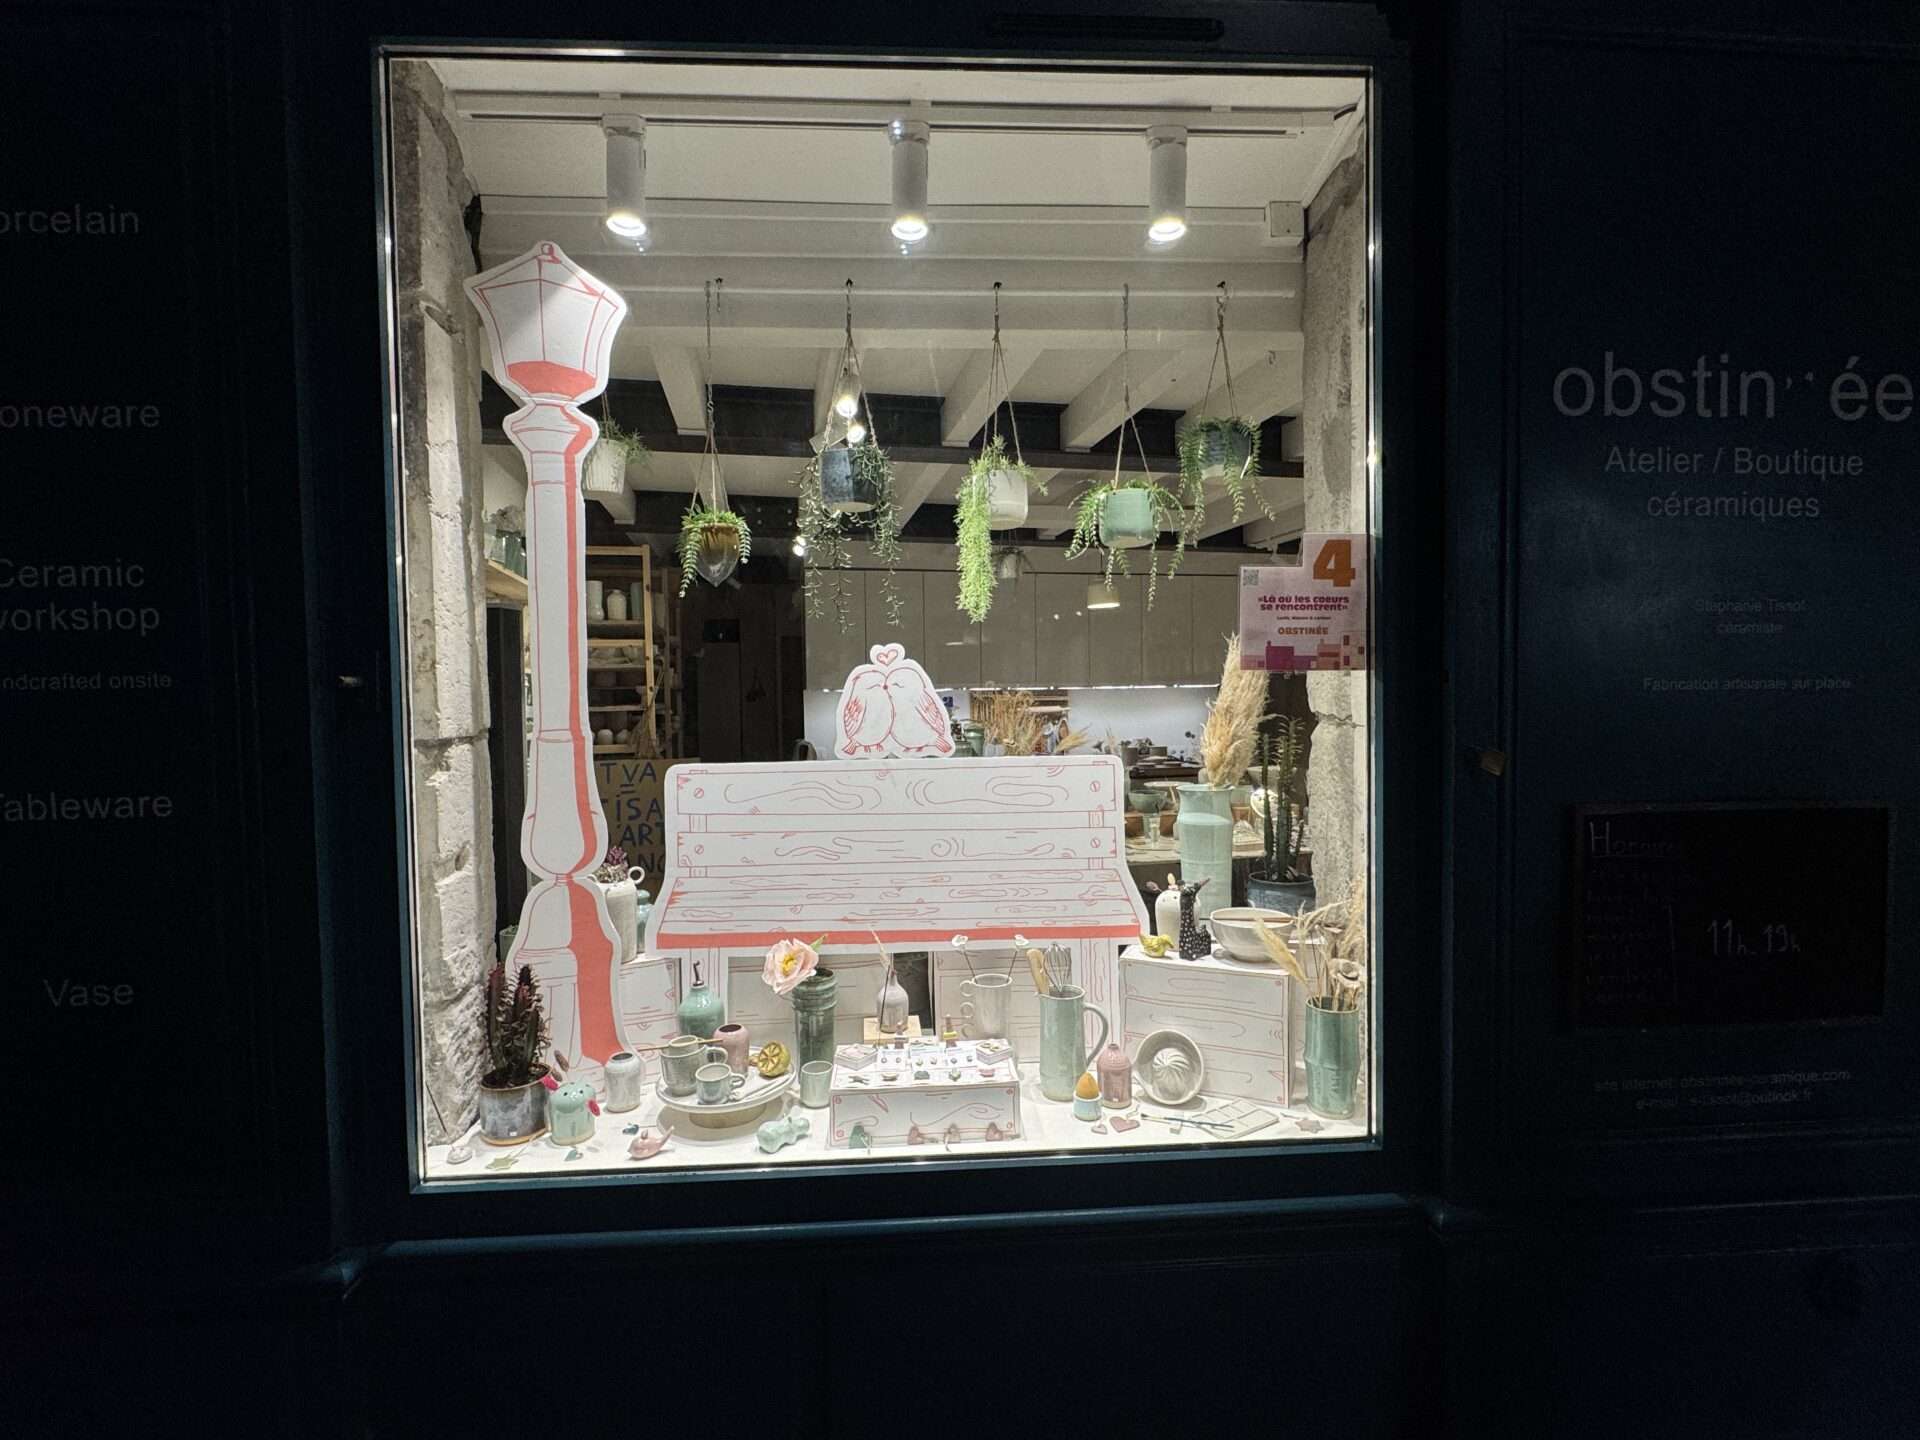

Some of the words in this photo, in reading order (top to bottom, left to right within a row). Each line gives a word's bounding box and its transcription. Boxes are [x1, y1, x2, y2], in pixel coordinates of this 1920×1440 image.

[0, 404, 160, 428] oneware
[1604, 446, 1704, 474] Atelier
[1733, 447, 1865, 480] Boutique
[1647, 491, 1820, 522] céramiques
[0, 557, 145, 588] Ceramic
[1313, 539, 1356, 587] 4
[1260, 603, 1273, 612] se
[1294, 594, 1311, 604] les
[1278, 624, 1329, 635] OBSTINÉE
[109, 670, 174, 690] onsite
[0, 792, 173, 822] ableware
[42, 978, 135, 1007] Vase
